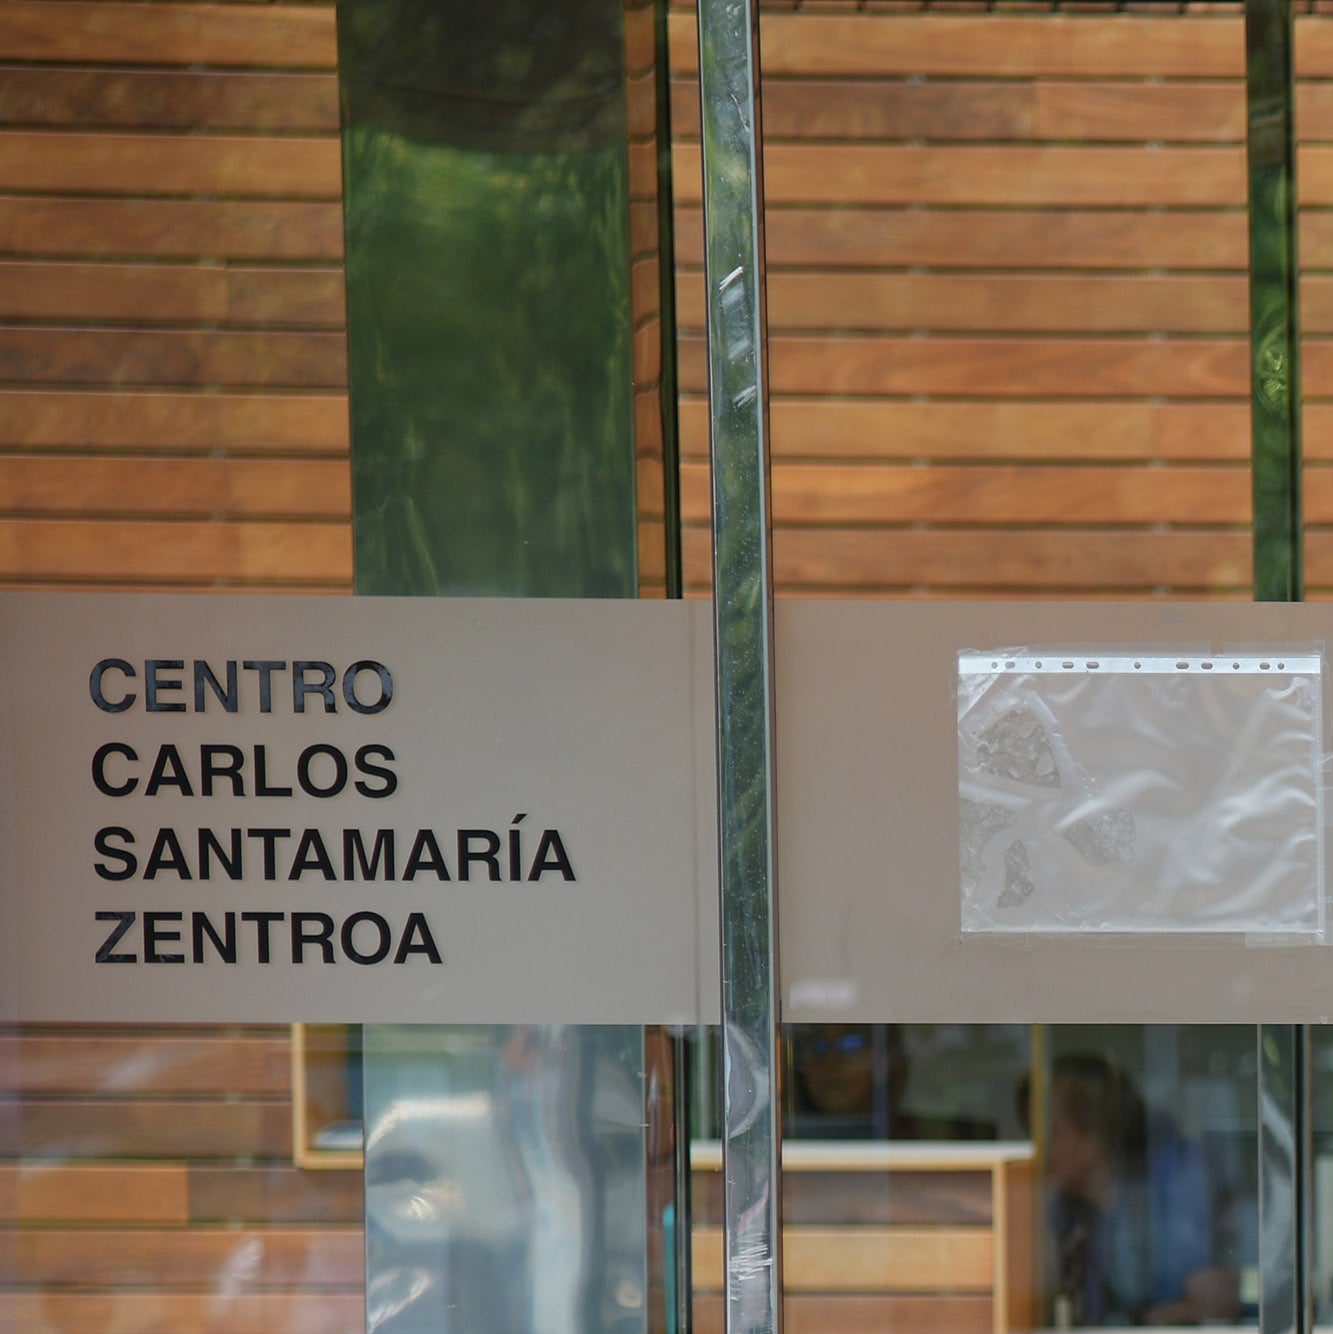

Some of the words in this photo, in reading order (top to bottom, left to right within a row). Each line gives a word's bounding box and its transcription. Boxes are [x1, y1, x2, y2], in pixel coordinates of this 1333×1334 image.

[89, 658, 394, 715] CENTRO
[91, 742, 399, 799] CARLOS
[93, 813, 577, 882] SANTAMARÍA
[94, 911, 443, 966] ZENTROA
